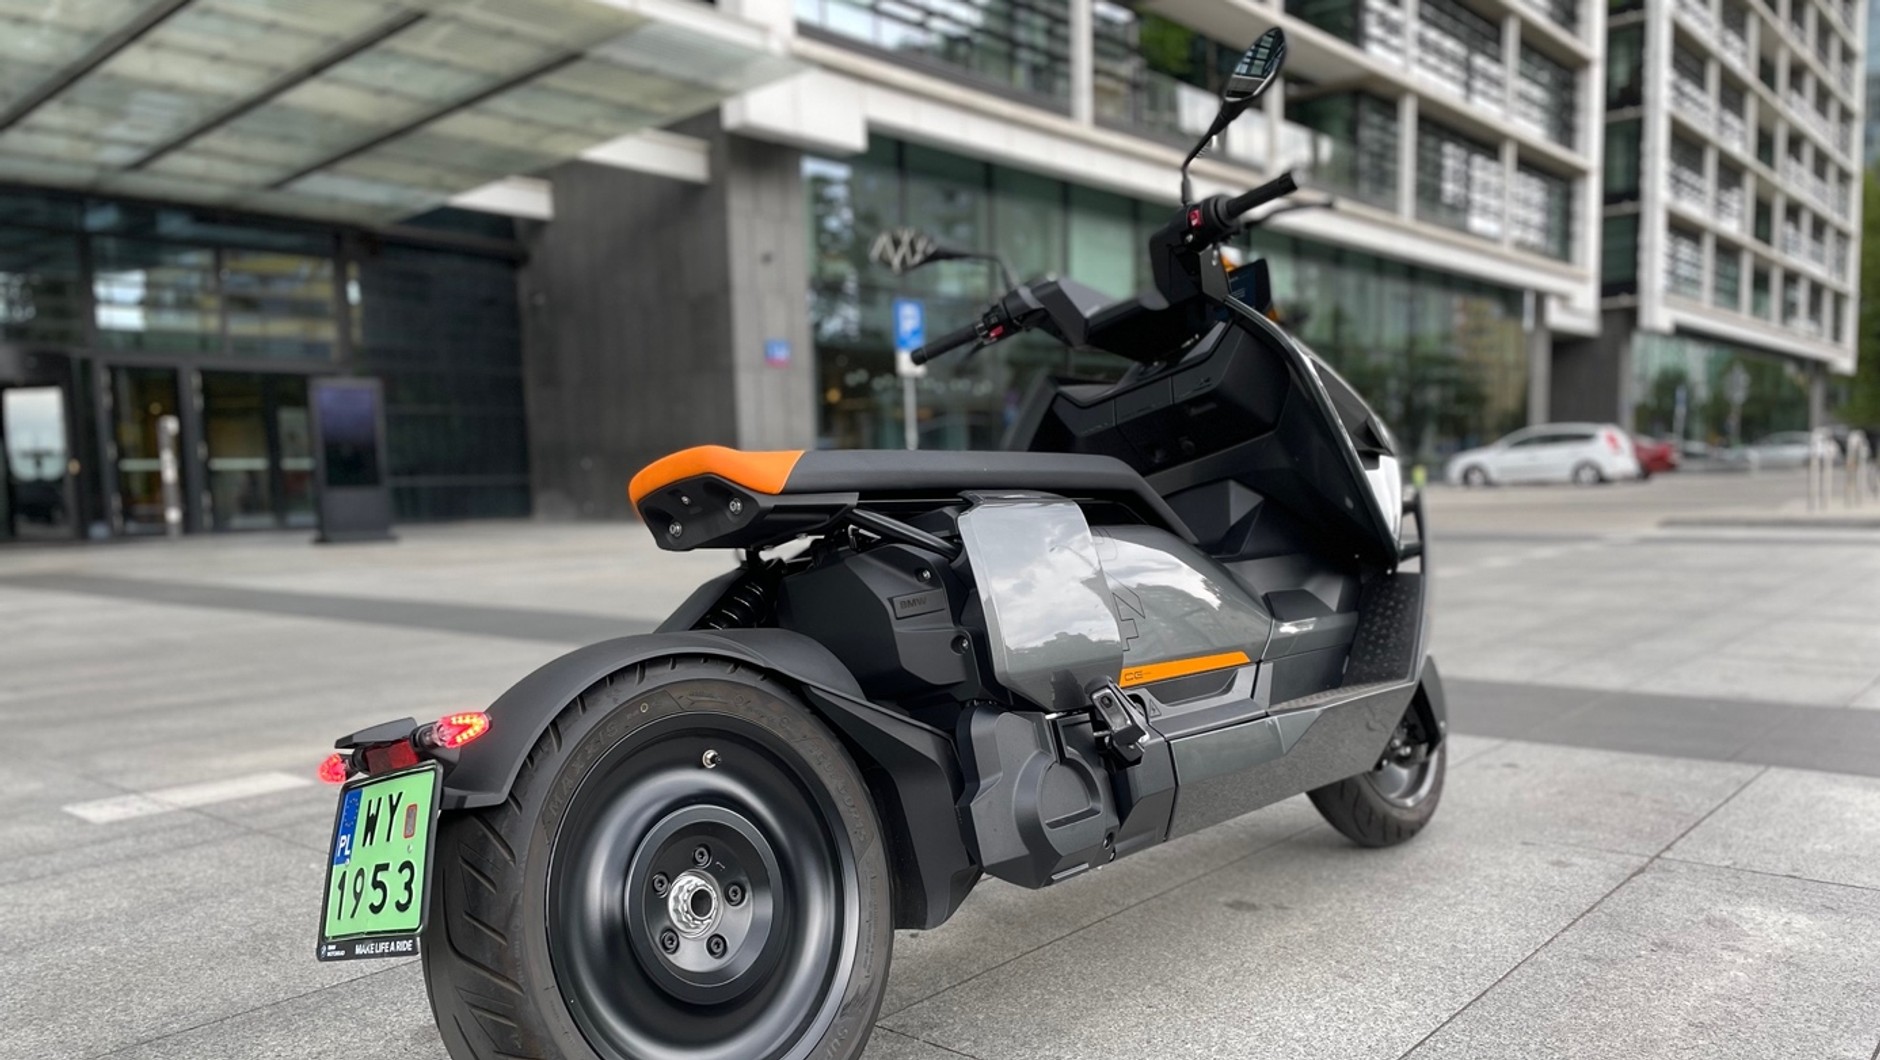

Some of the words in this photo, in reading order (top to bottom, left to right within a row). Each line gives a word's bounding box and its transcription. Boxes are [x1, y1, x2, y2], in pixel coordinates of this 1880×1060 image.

[898, 302, 921, 337] P
[899, 595, 928, 609] BMW
[362, 791, 404, 847] WY
[337, 834, 351, 857] PL
[337, 860, 415, 920] 1953
[355, 943, 375, 955] MAKE
[375, 942, 389, 954] LIFE
[396, 940, 413, 951] RIDE
